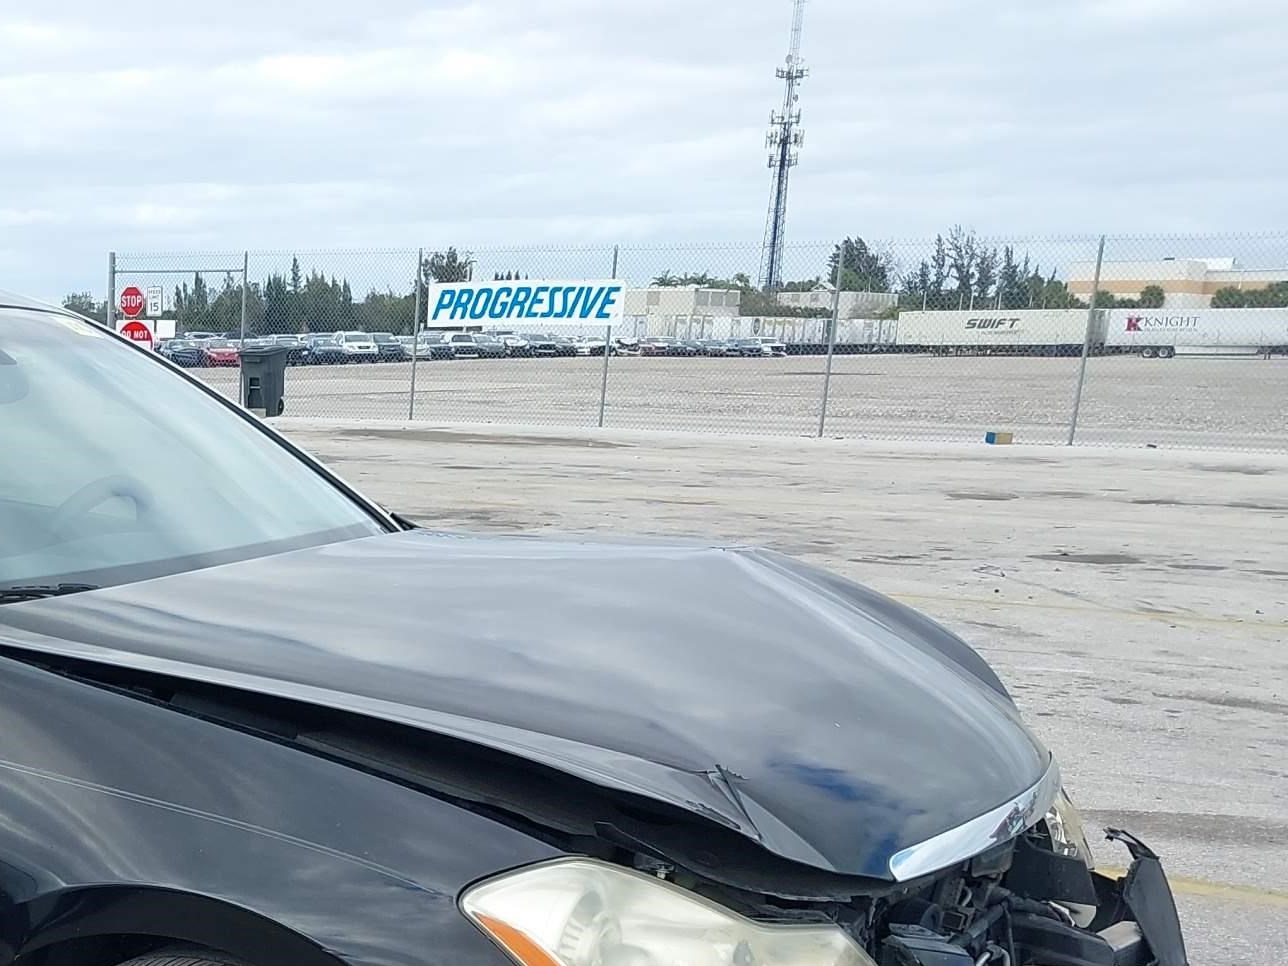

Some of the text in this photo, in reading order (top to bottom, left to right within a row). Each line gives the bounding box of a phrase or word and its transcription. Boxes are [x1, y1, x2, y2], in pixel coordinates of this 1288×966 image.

[121, 295, 142, 308] STOP
[150, 302, 159, 312] 15
[432, 286, 622, 320] PROGRESSIVE
[965, 318, 1021, 329] SWIFT
[1144, 316, 1201, 327] KNIGHT
[134, 330, 148, 339] NOT
